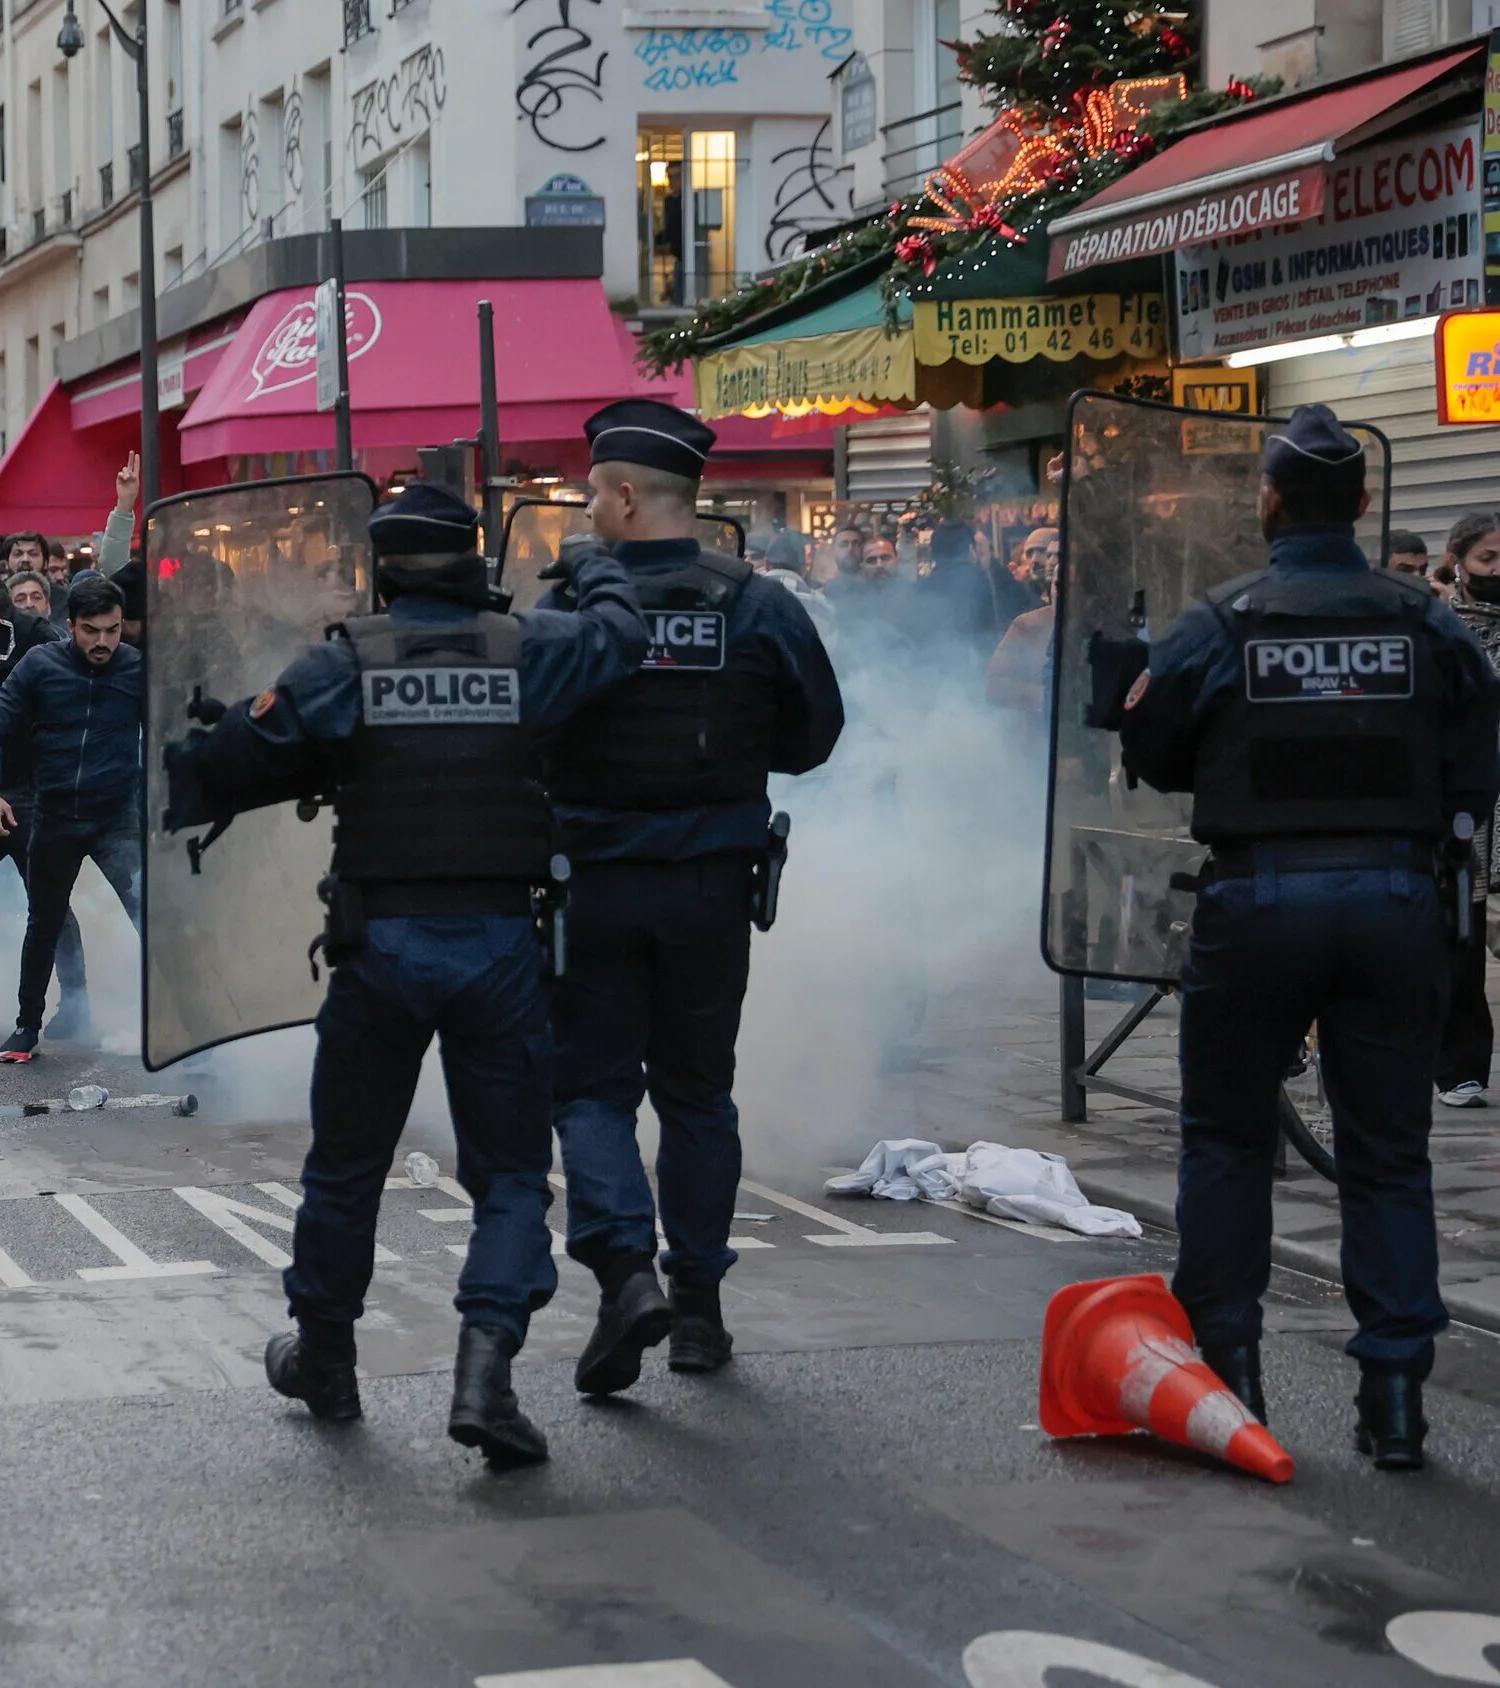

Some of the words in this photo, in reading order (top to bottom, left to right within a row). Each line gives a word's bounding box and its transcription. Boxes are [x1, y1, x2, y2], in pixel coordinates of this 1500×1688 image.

[1320, 137, 1474, 224] ELECOM
[1063, 213, 1179, 272] RÉPARATION
[1180, 179, 1301, 243] DÉBLOCAGE
[1232, 262, 1266, 294] GSM
[1288, 224, 1430, 283] INFORMATIQUES
[936, 295, 1097, 332] Hammamet
[1213, 302, 1244, 324] VENTE
[1261, 293, 1290, 315] GROS
[1297, 284, 1335, 308] DÉTAIL
[1338, 272, 1400, 299] TELEPHONE
[948, 333, 988, 357] Tel:
[1005, 331, 1028, 354] 01
[1047, 329, 1073, 351] 42
[1088, 327, 1114, 350] 46
[1130, 326, 1155, 348] 41
[1193, 385, 1242, 412] WU
[650, 615, 717, 647] ICE
[1256, 641, 1406, 678] POLICE
[371, 673, 512, 706] POLICE
[1302, 676, 1339, 689] BRAV
